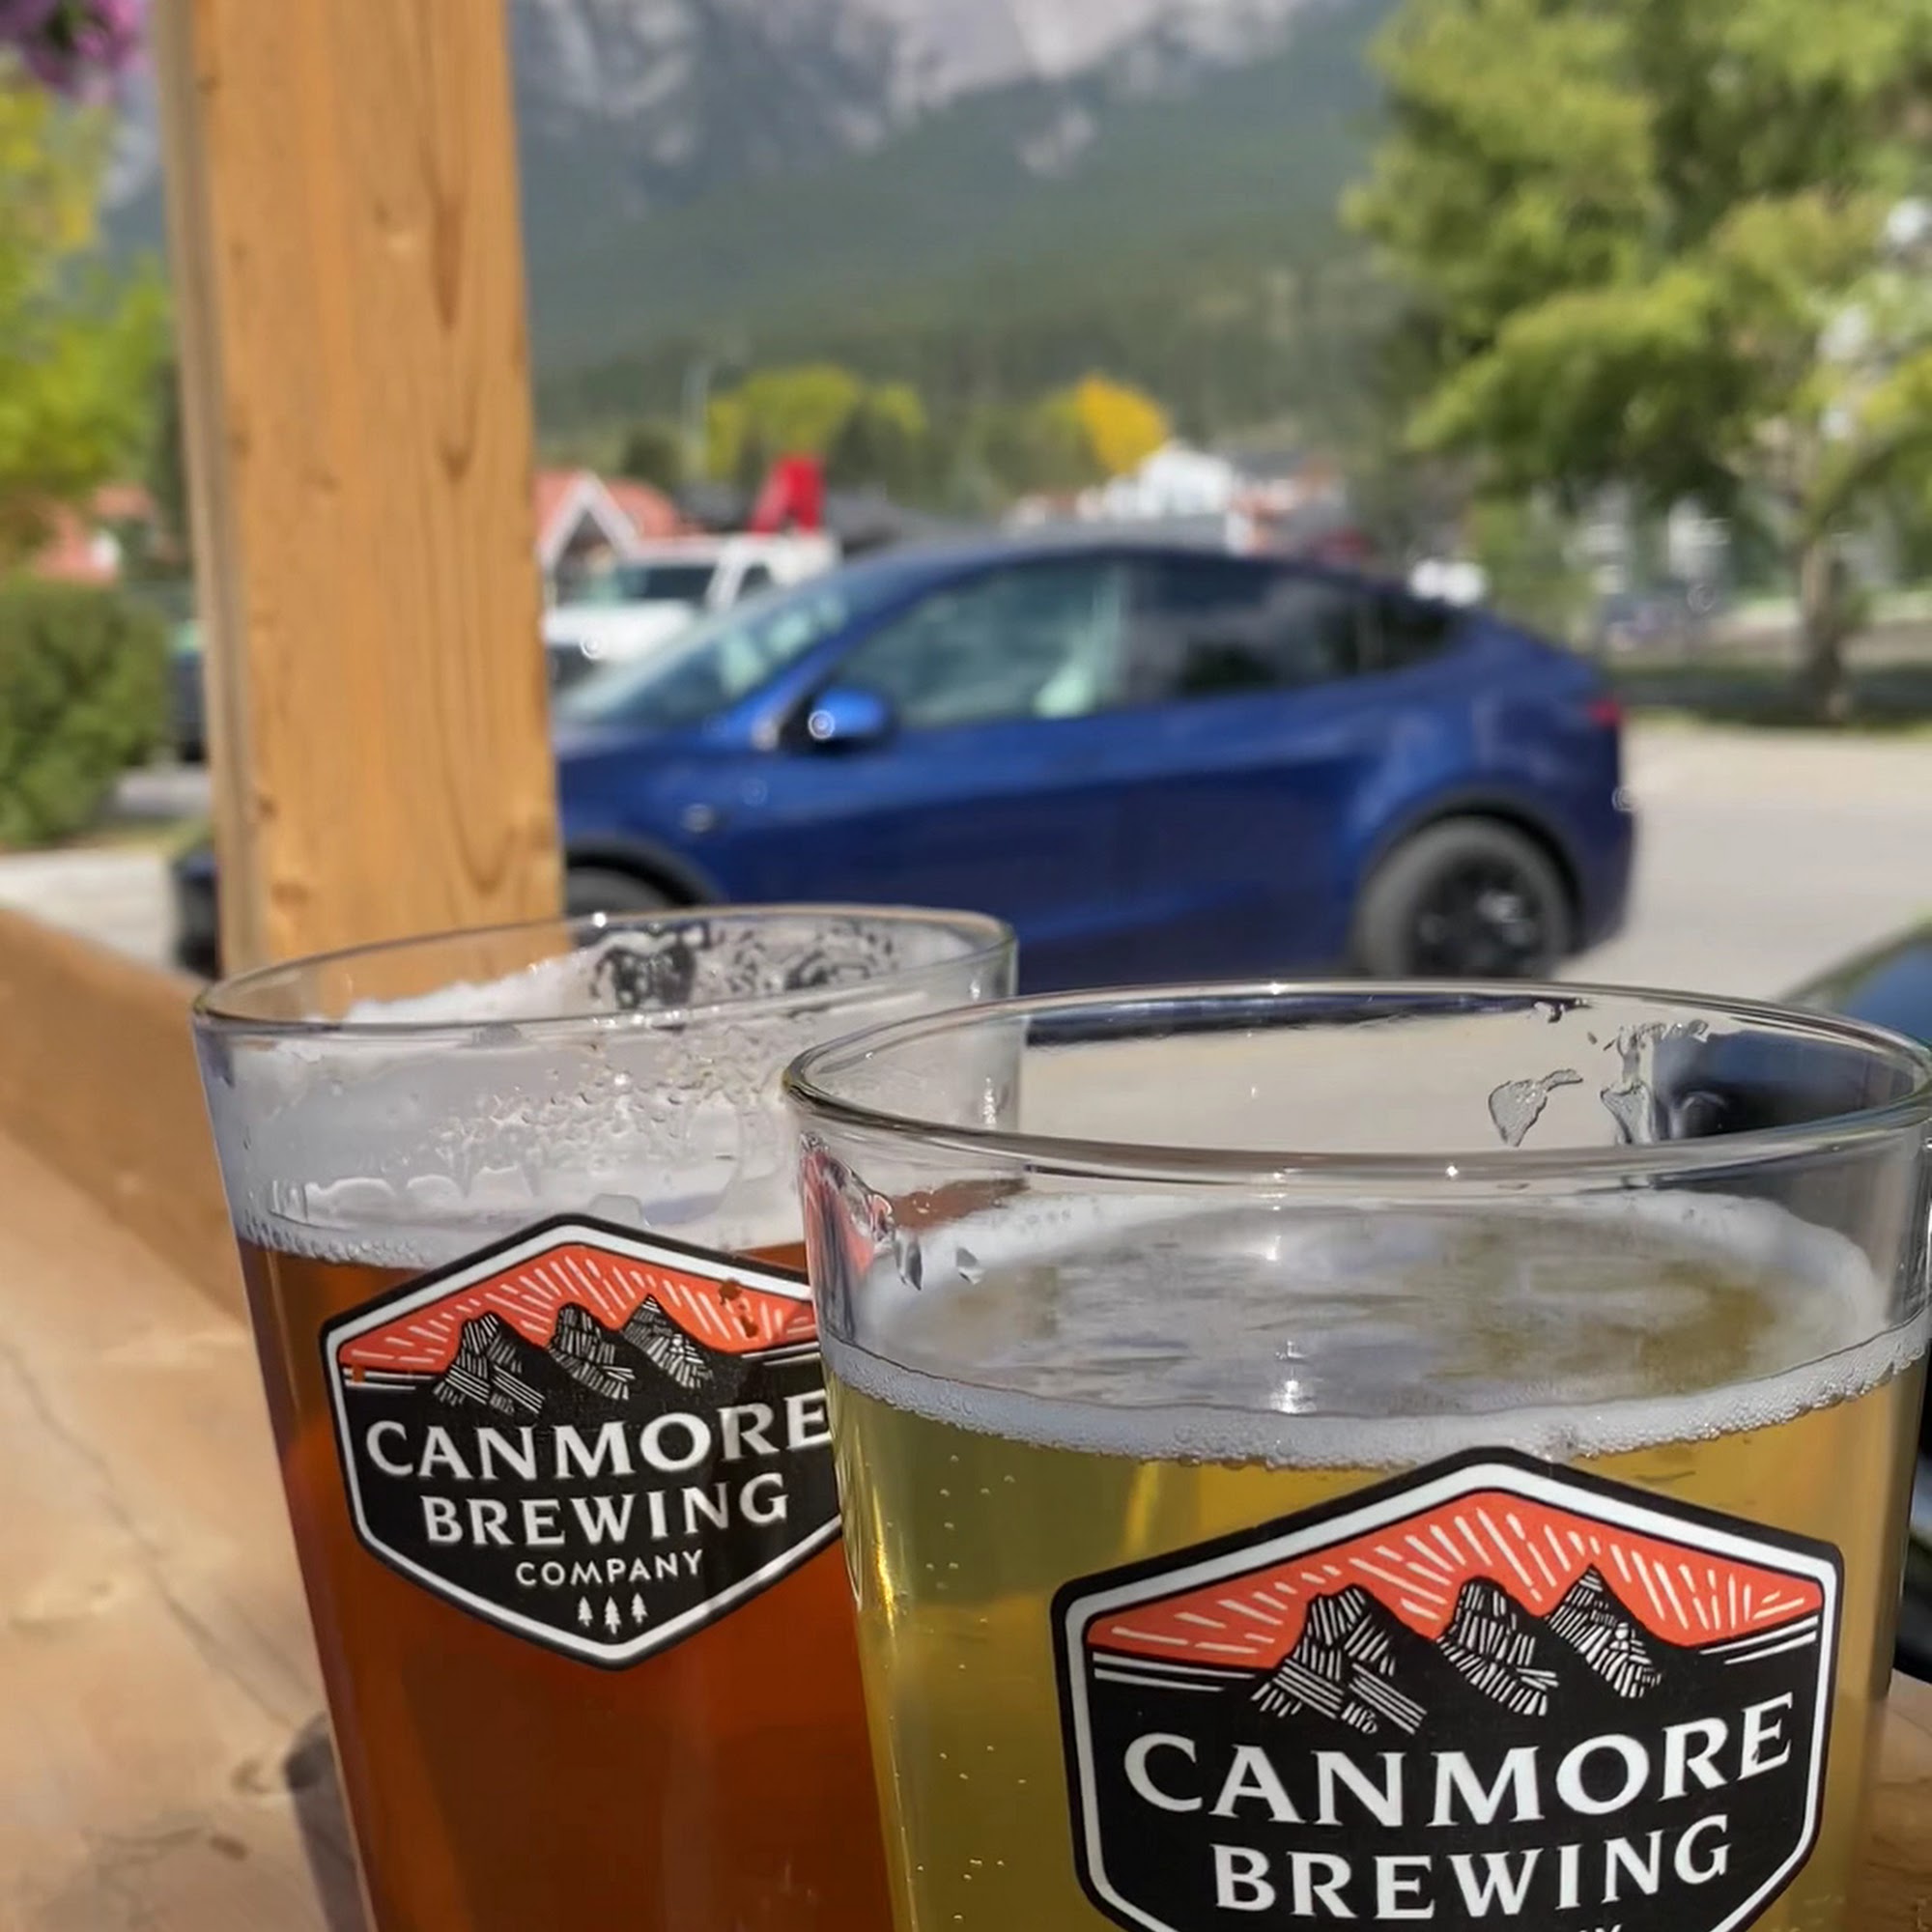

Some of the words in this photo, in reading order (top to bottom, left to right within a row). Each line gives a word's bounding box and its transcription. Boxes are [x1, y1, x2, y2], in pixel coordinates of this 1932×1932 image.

[366, 1388, 833, 1481] CANMORE
[420, 1473, 788, 1546] BREWING
[515, 1548, 704, 1586] COMPANY
[1123, 1692, 1793, 1828] CANMORE
[1211, 1815, 1729, 1919] BREWING
